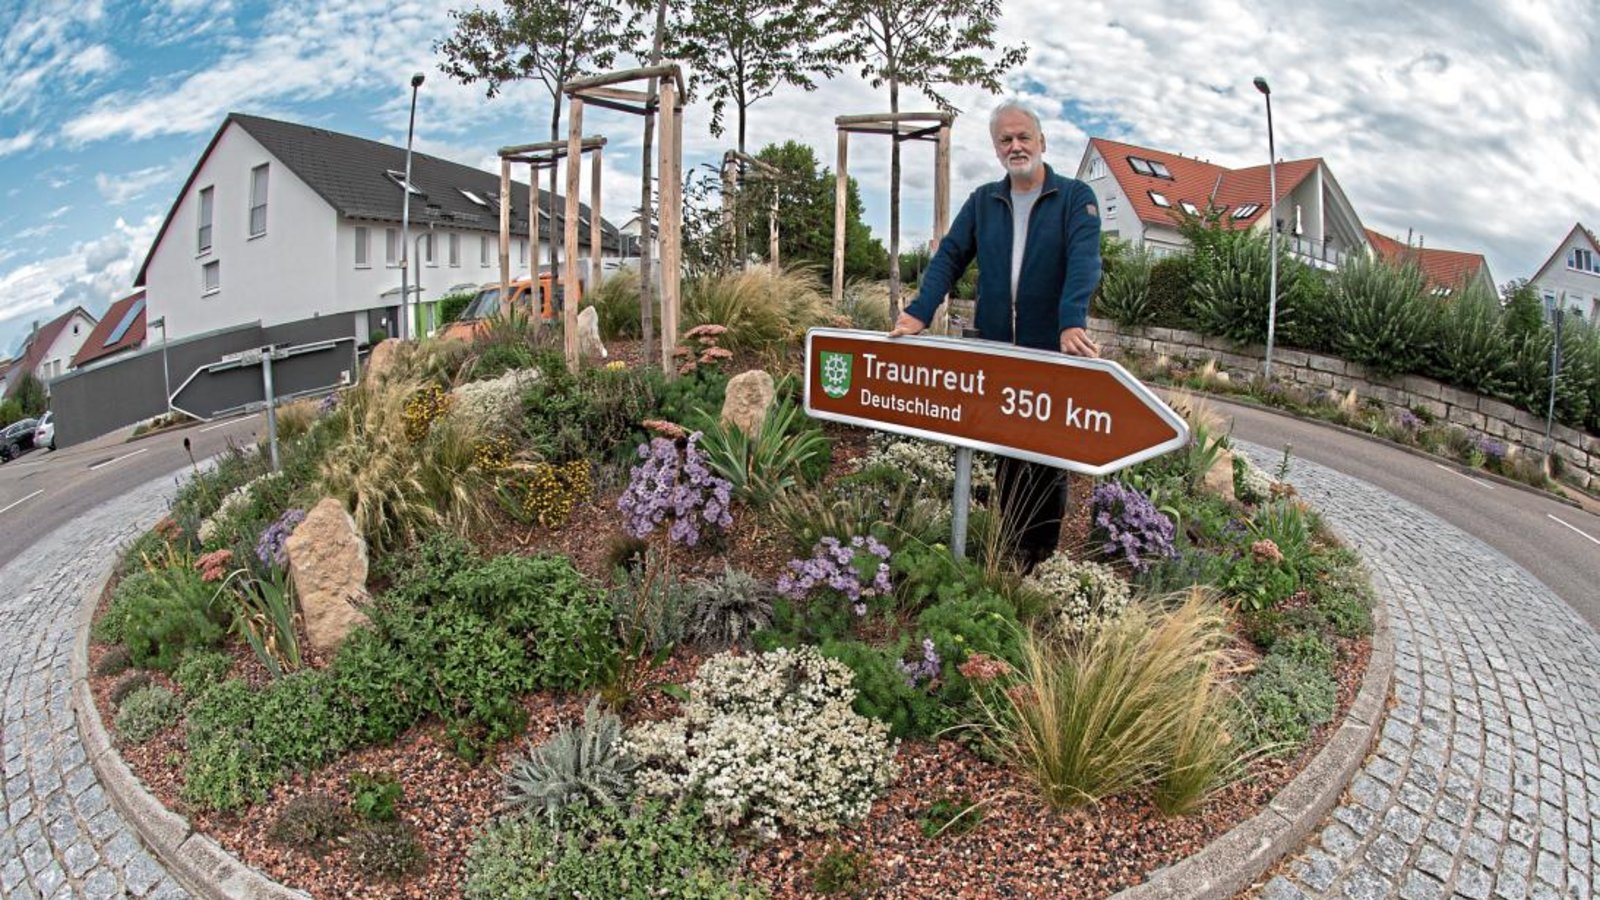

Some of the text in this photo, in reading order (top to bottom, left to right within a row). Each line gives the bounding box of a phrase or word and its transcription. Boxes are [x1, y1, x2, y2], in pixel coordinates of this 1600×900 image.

[862, 353, 986, 396] Traunreut
[861, 389, 962, 422] Deutschland
[1000, 387, 1112, 434] 350 km
